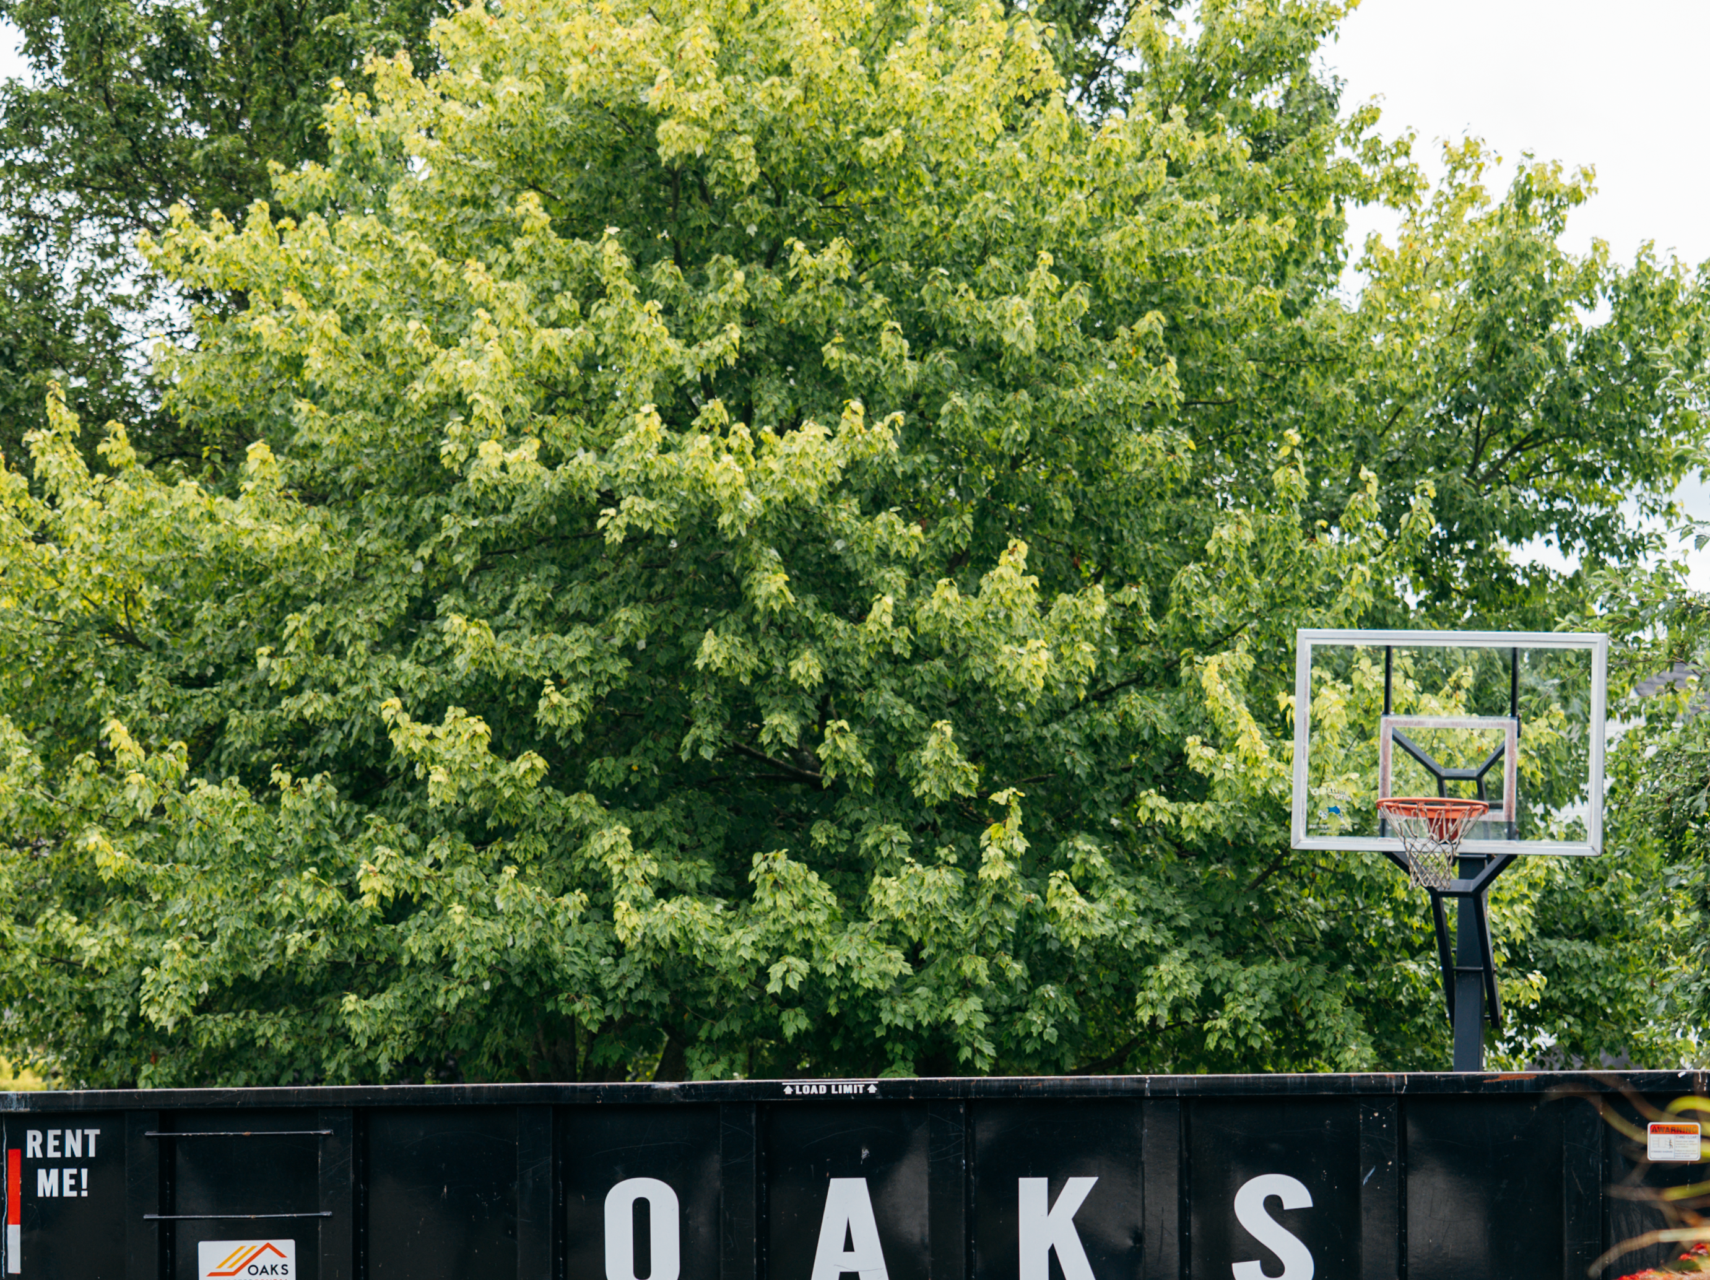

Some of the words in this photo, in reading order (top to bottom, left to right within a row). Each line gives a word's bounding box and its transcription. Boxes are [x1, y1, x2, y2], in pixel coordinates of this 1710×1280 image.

[795, 1084, 827, 1095] LOAD
[831, 1084, 865, 1094] LIMIT
[26, 1128, 101, 1158] RENT
[37, 1168, 89, 1197] ME!
[247, 1264, 289, 1276] OAKS
